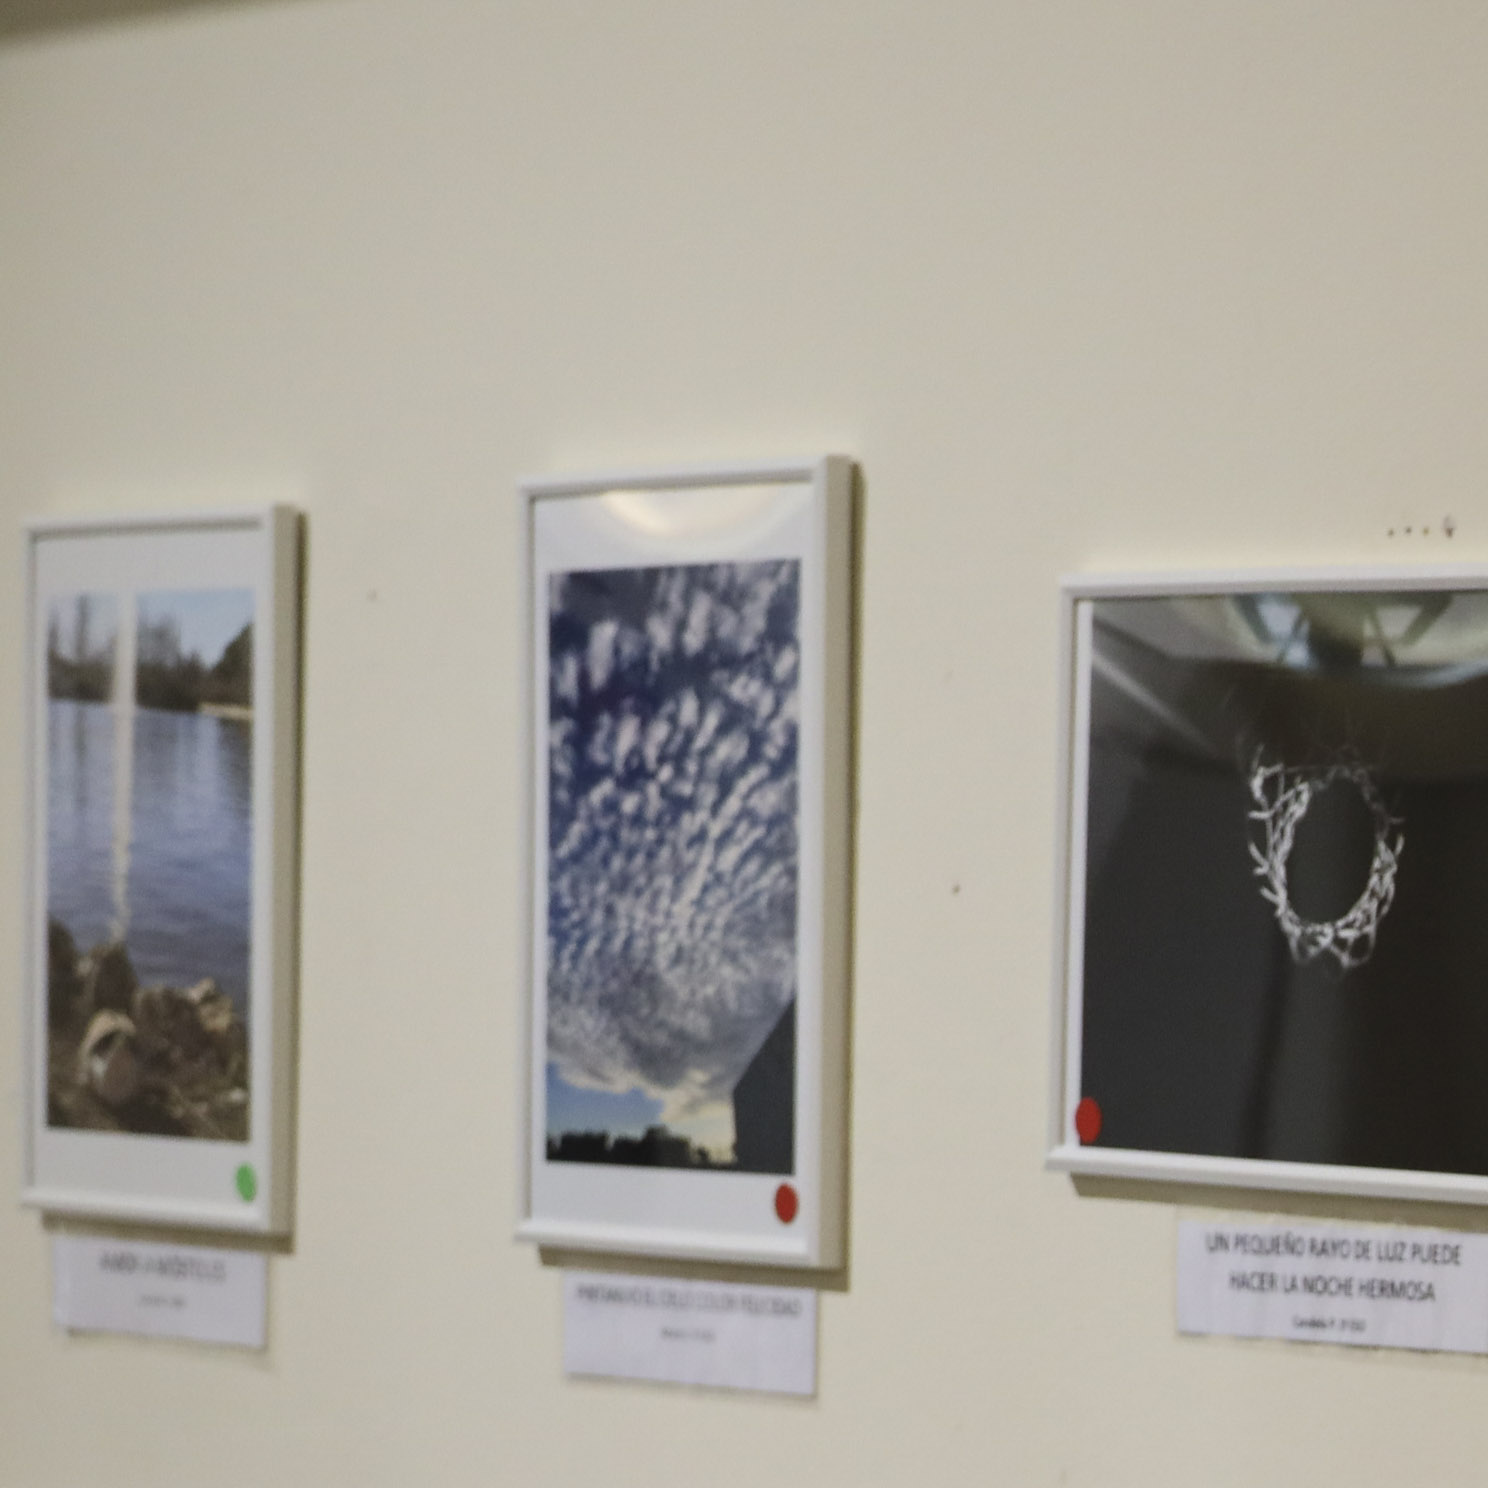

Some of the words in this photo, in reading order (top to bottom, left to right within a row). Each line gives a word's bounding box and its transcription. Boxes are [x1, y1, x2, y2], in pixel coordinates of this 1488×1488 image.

[1206, 1231, 1230, 1252] UN
[1234, 1230, 1304, 1257] PEQUEÑO
[1310, 1237, 1350, 1260] RAYO
[1354, 1240, 1372, 1261] DE
[1377, 1242, 1406, 1263] LUZ
[1411, 1243, 1463, 1266] PUEDE
[1229, 1271, 1279, 1293] HACER
[1284, 1274, 1299, 1294] LA
[1303, 1275, 1354, 1298] NOCHE
[1358, 1278, 1436, 1302] HERMOSA
